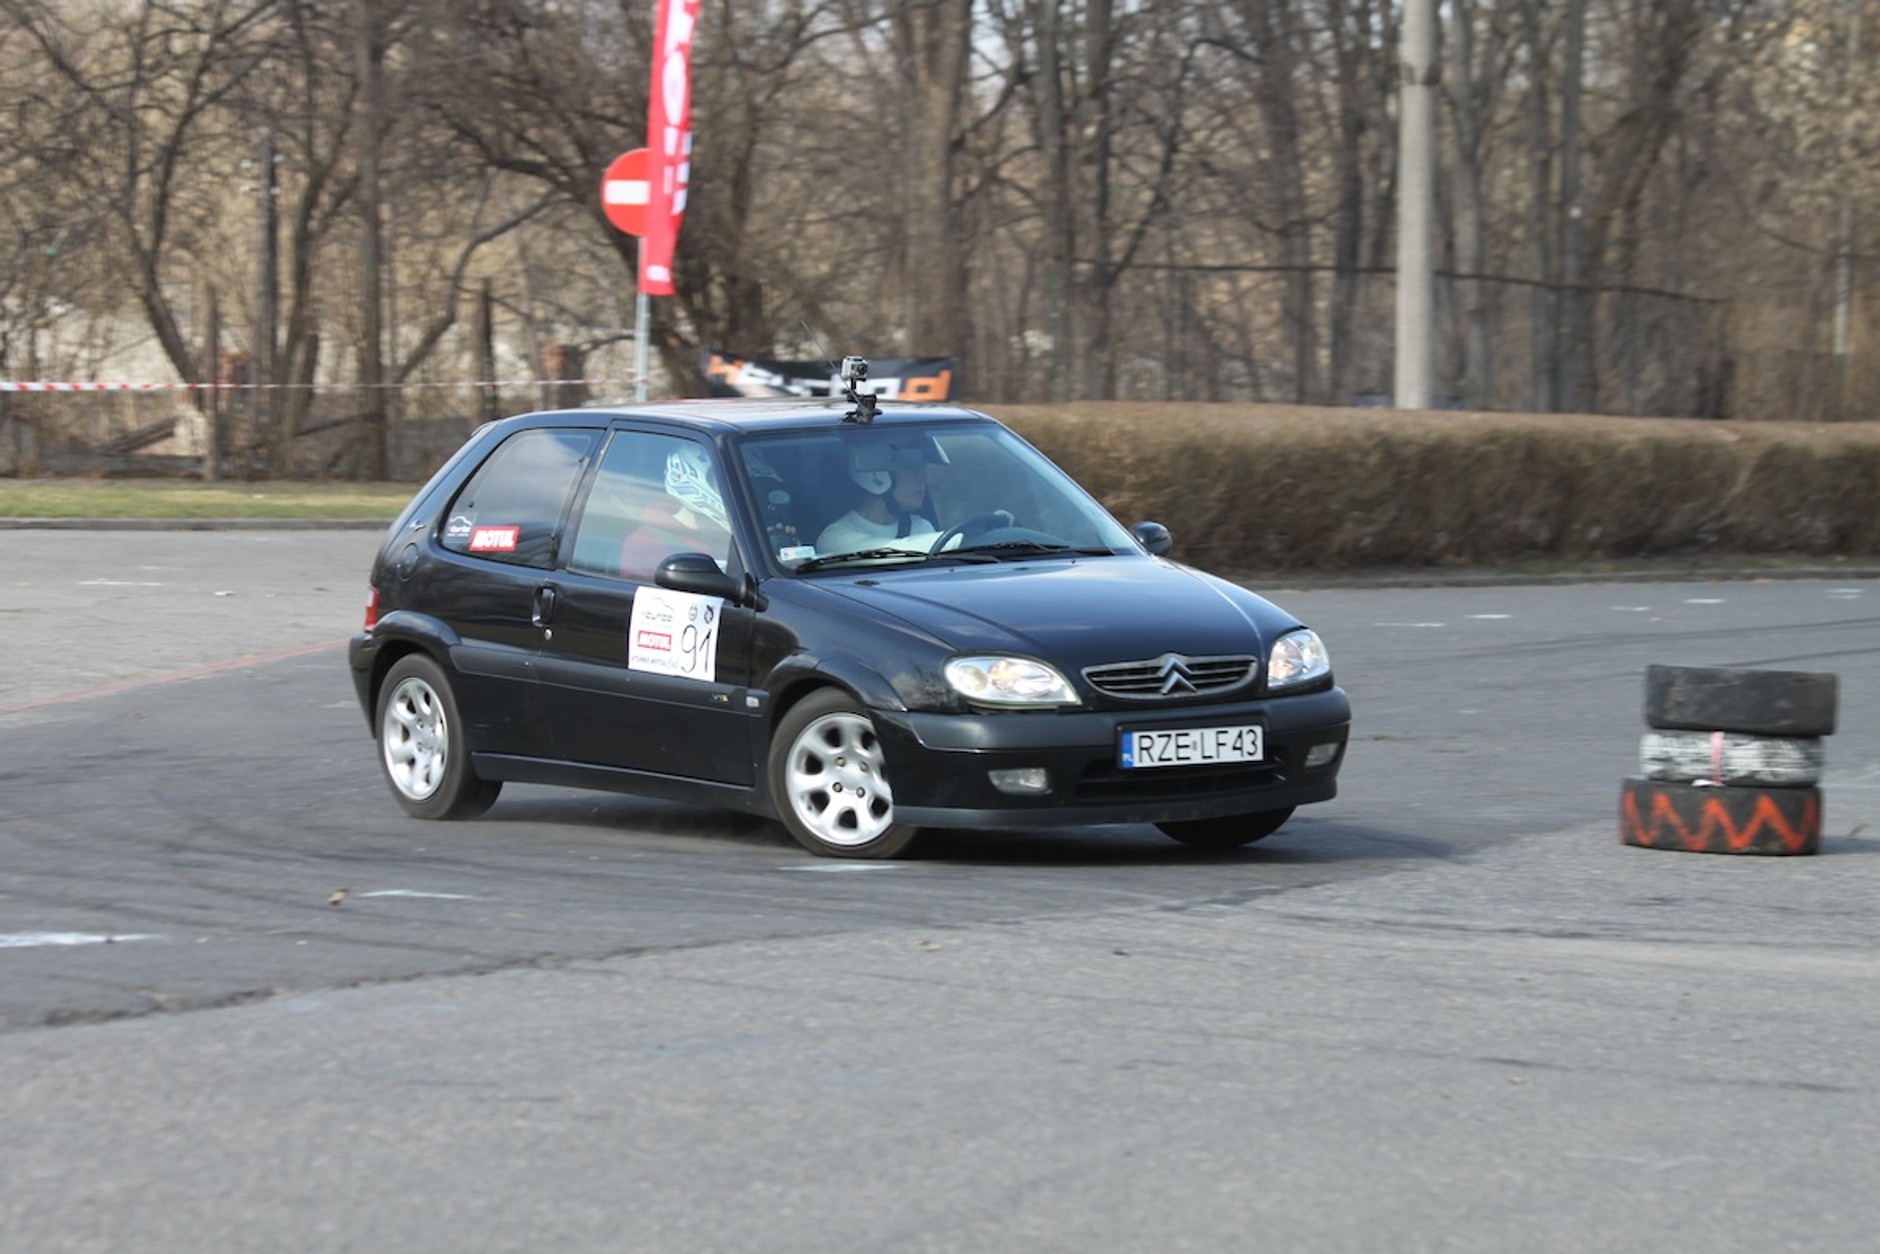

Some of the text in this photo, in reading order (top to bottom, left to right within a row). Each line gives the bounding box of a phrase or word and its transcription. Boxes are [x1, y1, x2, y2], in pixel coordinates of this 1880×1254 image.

[472, 530, 515, 548] MOTUL
[639, 632, 671, 650] MOTUL
[681, 624, 712, 673] 91
[1138, 732, 1191, 763] RZE
[1200, 729, 1258, 760] LF43
